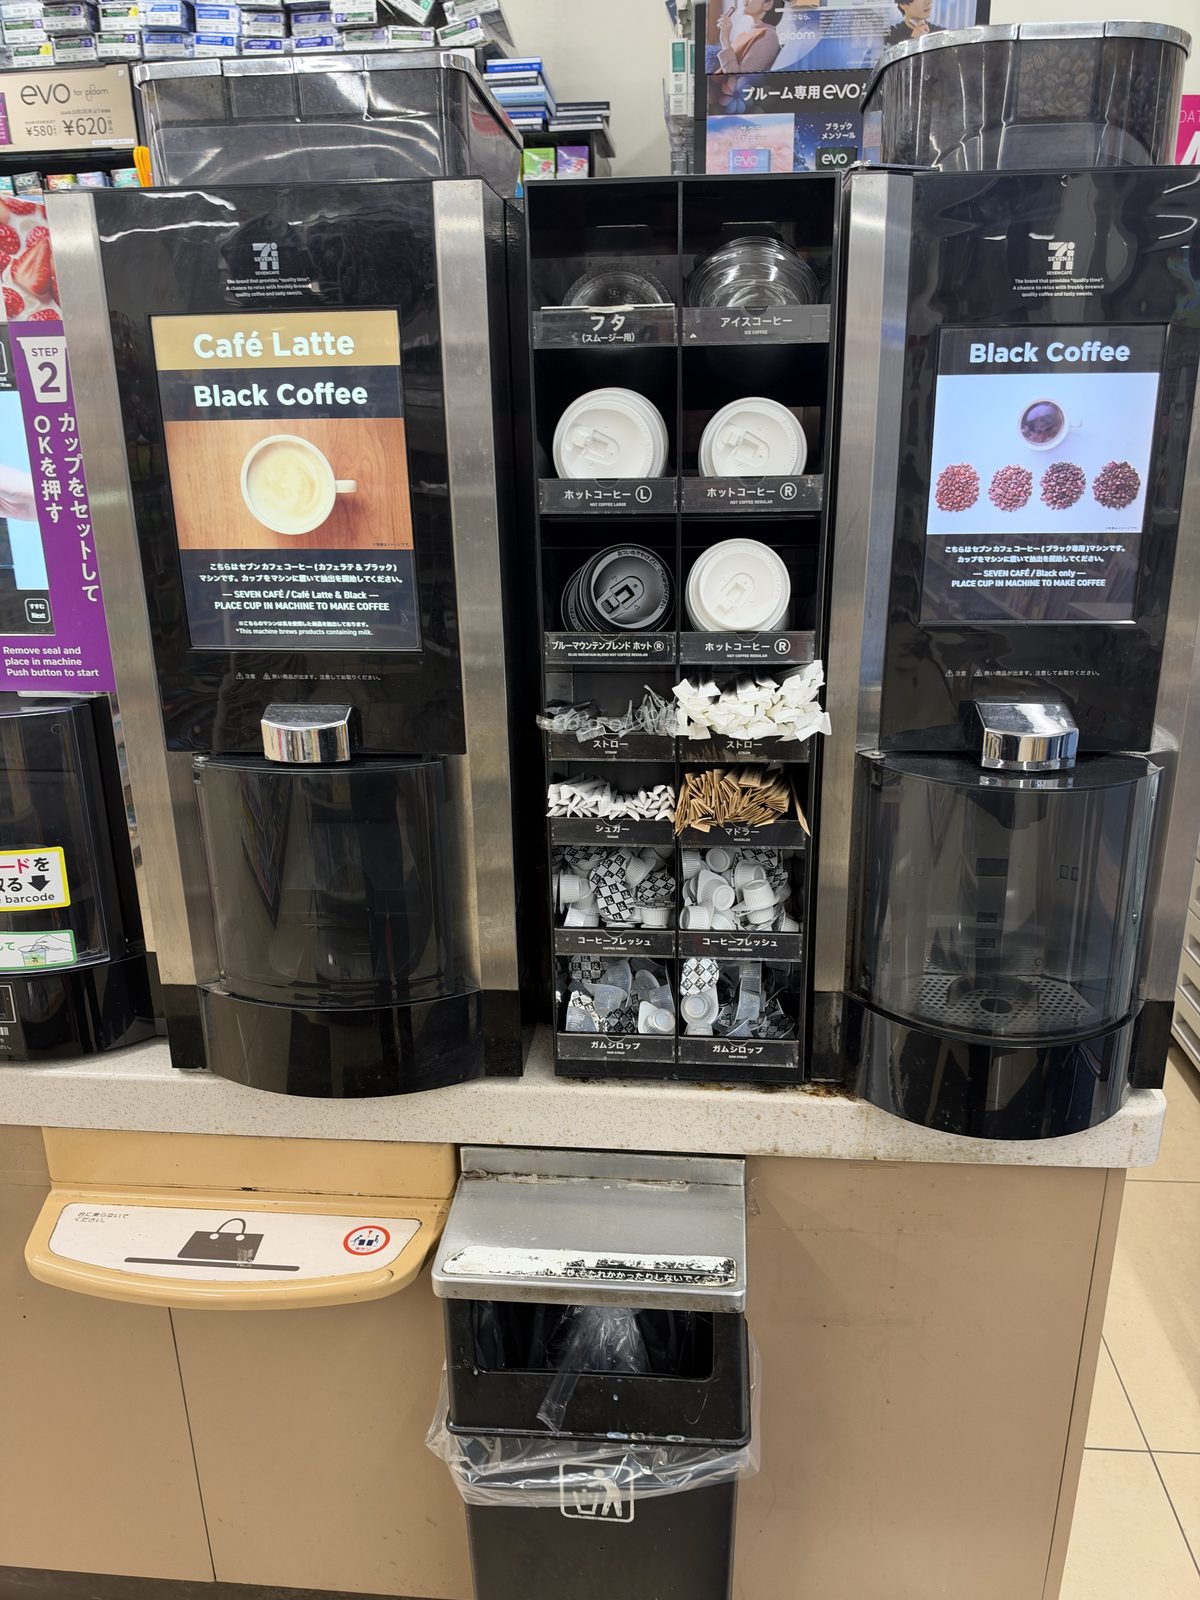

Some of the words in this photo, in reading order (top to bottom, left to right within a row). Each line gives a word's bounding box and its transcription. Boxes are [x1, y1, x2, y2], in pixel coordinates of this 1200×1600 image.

[20, 83, 71, 106] evo
[62, 117, 108, 136] ¥620
[821, 153, 848, 165] evo
[720, 317, 793, 328] アイスコーヒー
[581, 332, 635, 344] (スムージー用)
[194, 330, 263, 359] Café
[270, 329, 355, 357] Latte
[31, 347, 58, 357] STEP
[970, 342, 1039, 363] Black
[1046, 341, 1130, 362] Coffee
[37, 362, 61, 393] 2
[194, 383, 269, 407] Black
[277, 382, 368, 406] Coffee
[34, 415, 63, 524] OKを押す
[564, 489, 632, 500] ホットコーヒー
[707, 487, 776, 498] ホットコーヒー
[58, 412, 100, 602] カップをセットして
[983, 569, 1009, 578] SEVEN
[1010, 568, 1030, 577] CAFÉ
[1035, 569, 1058, 577] Black
[1058, 569, 1076, 578] only
[952, 580, 976, 588] PLACE
[977, 579, 994, 587] CUP
[1005, 579, 1041, 587] MACHINE
[1042, 579, 1052, 587] TO
[1053, 579, 1076, 587] MAKE
[1077, 579, 1106, 587] COFFEE
[234, 590, 262, 598] SEVEN
[262, 590, 284, 599] CAFÉ
[291, 590, 310, 599] Café
[312, 590, 334, 599] Latte
[335, 590, 342, 599] &
[344, 590, 368, 599] Black
[214, 601, 242, 610] PLACE
[243, 601, 262, 610] CUP
[264, 602, 274, 610] IN
[275, 602, 315, 610] MACHINE
[316, 602, 328, 610] TO
[330, 602, 356, 611] MAKE
[356, 602, 390, 611] COFFEE
[3, 646, 40, 655] Remove
[42, 646, 61, 655] seal
[63, 646, 81, 655] and
[633, 641, 652, 650] ホット
[705, 642, 770, 652] ホットコーヒー
[5, 657, 30, 667] place
[32, 657, 41, 666] in
[43, 657, 82, 666] machine
[6, 668, 29, 676] Push
[30, 668, 62, 677] button
[64, 669, 75, 677] to
[77, 669, 100, 677] start
[593, 740, 629, 748] ストロー
[726, 740, 763, 749] ストロー
[595, 824, 630, 834] シュガー
[724, 827, 760, 836] マドラー
[5, 892, 55, 904] barcode
[578, 937, 652, 946] コーヒーフレッシュ
[702, 938, 778, 947] コーヒーフレッシュ
[590, 1041, 641, 1050] ガムシロップ
[712, 1045, 764, 1054] ガムシロップ
